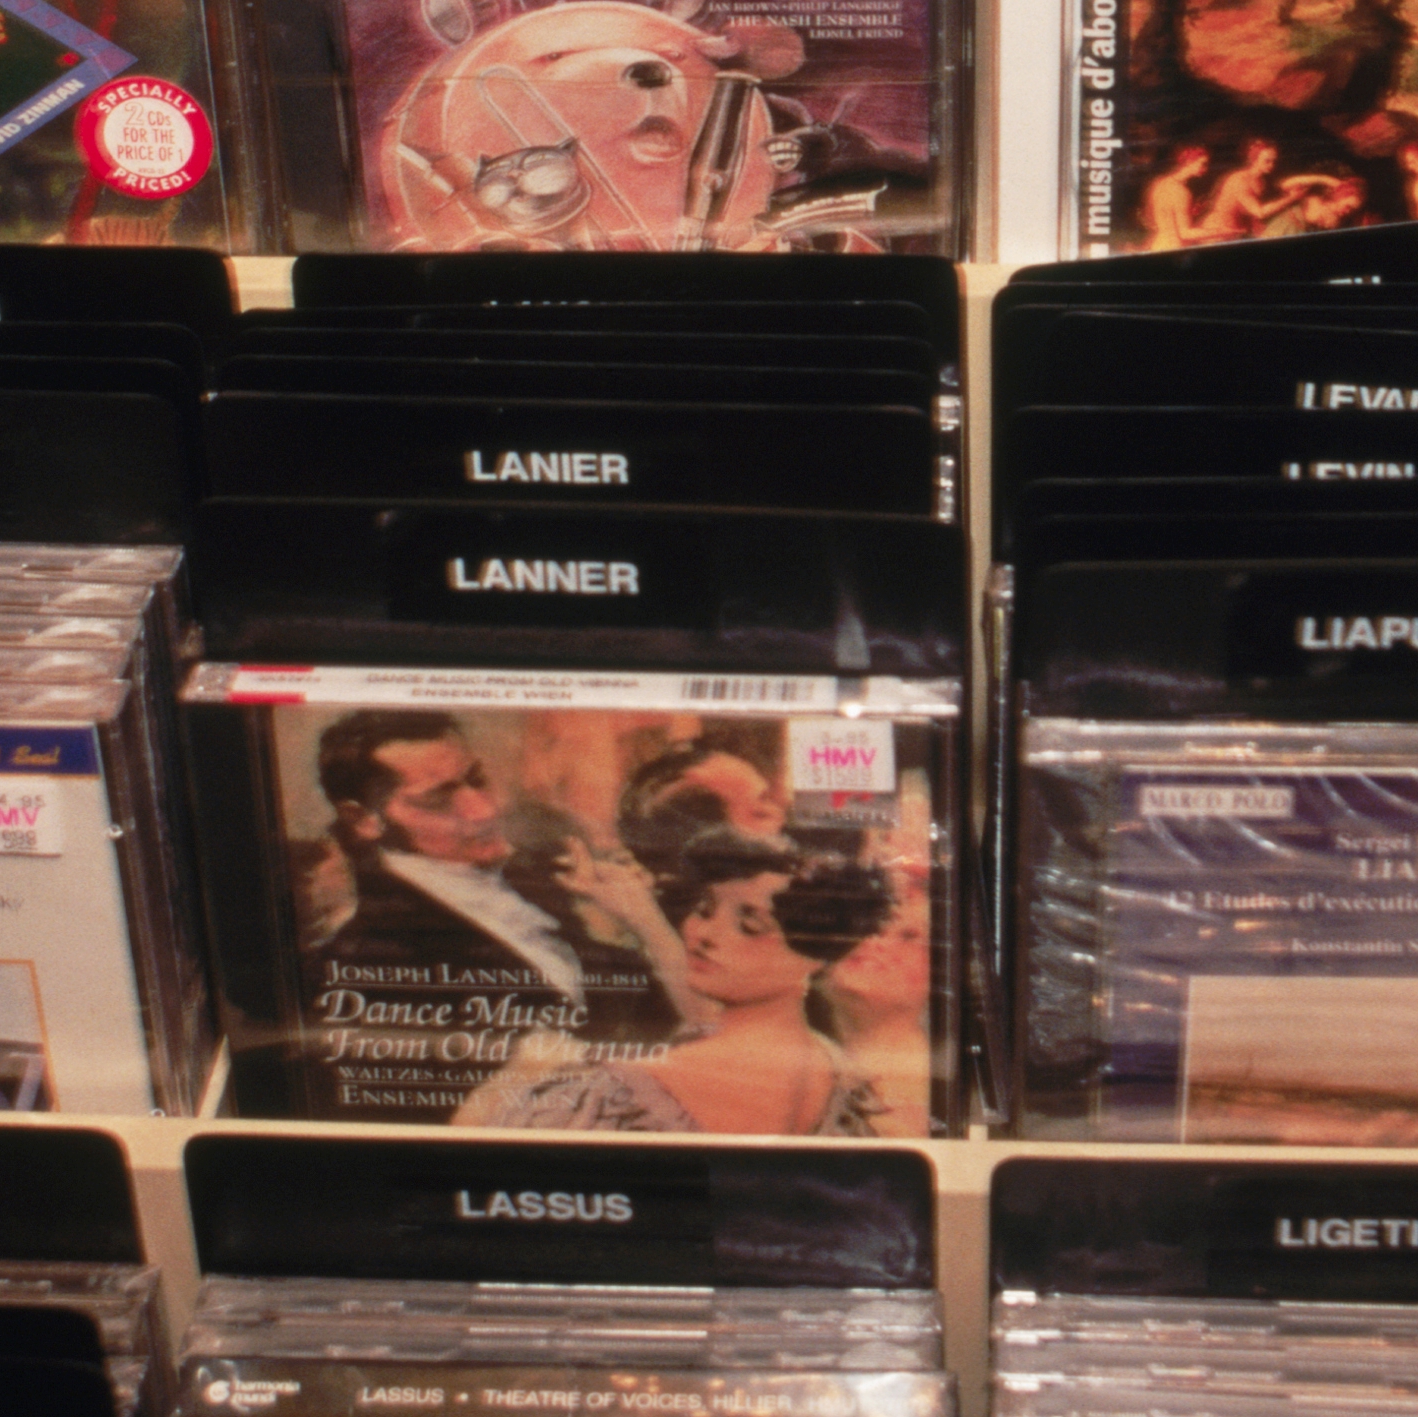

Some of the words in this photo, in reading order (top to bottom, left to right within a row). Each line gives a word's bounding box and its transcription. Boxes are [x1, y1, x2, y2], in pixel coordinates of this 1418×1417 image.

[726, 15, 758, 27] THE
[765, 15, 808, 27] NASH
[814, 15, 902, 26] ENSEMBLE
[18, 78, 86, 127] ZINMAN
[97, 82, 196, 119] SPECIALLY
[112, 166, 192, 193] PRICED!
[1085, 103, 1123, 237] musique
[472, 451, 628, 483] LANIER
[455, 559, 639, 594] LANNER
[809, 746, 876, 766] HMV
[320, 991, 457, 1027] Dance
[464, 992, 589, 1028] Music
[325, 1029, 437, 1064] From
[442, 1027, 511, 1063] Old
[526, 1029, 670, 1066] Vienna
[459, 1190, 634, 1222] LASSUS
[362, 1387, 444, 1405] LASSUS
[484, 1388, 580, 1408] THEATRE
[587, 1390, 615, 1408] OF
[621, 1390, 706, 1411] VOICES,
